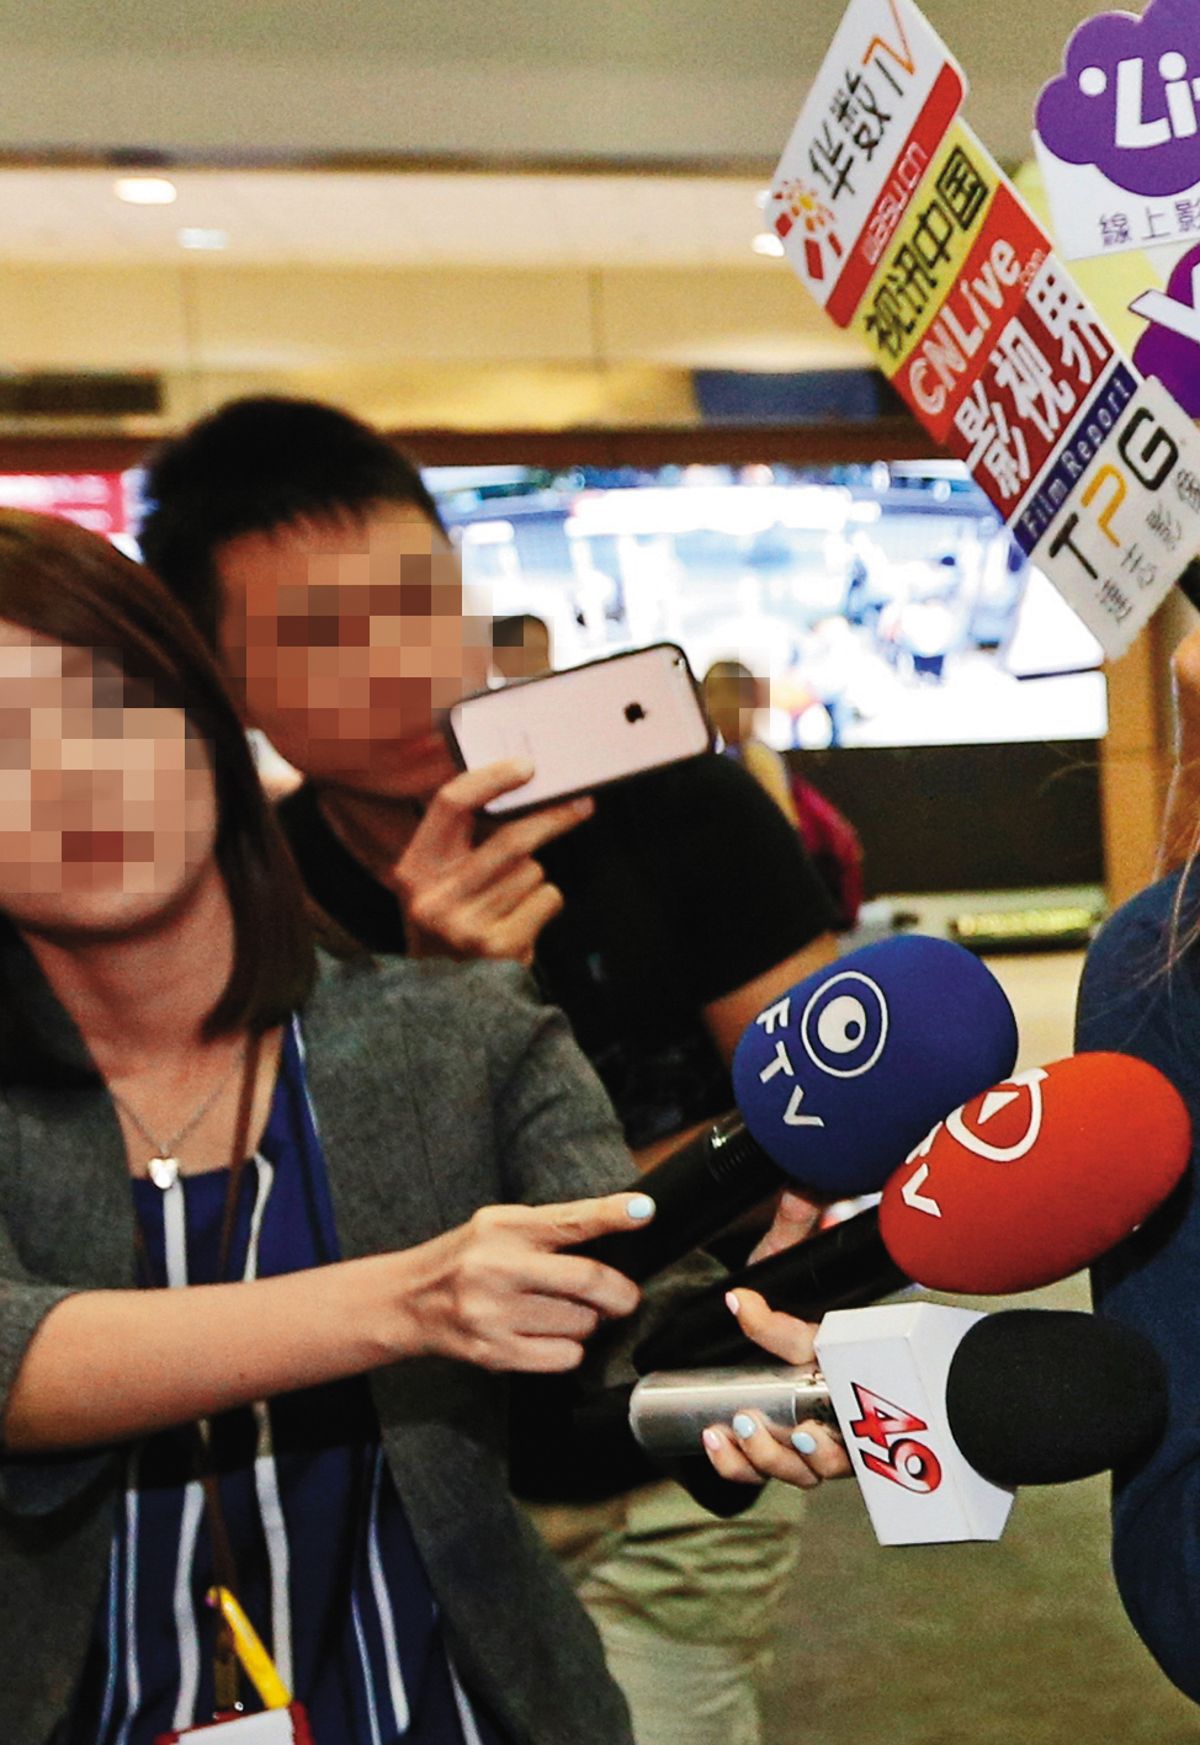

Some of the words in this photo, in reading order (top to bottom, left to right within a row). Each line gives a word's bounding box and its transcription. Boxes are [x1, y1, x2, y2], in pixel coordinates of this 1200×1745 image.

[864, 143, 988, 358] 视讯中国
[954, 254, 1108, 498] 影视界
[1020, 478, 1068, 538] Film
[1061, 377, 1129, 476] Report
[1049, 407, 1178, 579] TPG
[756, 996, 824, 1127] FTV
[850, 1381, 943, 1495] 49
